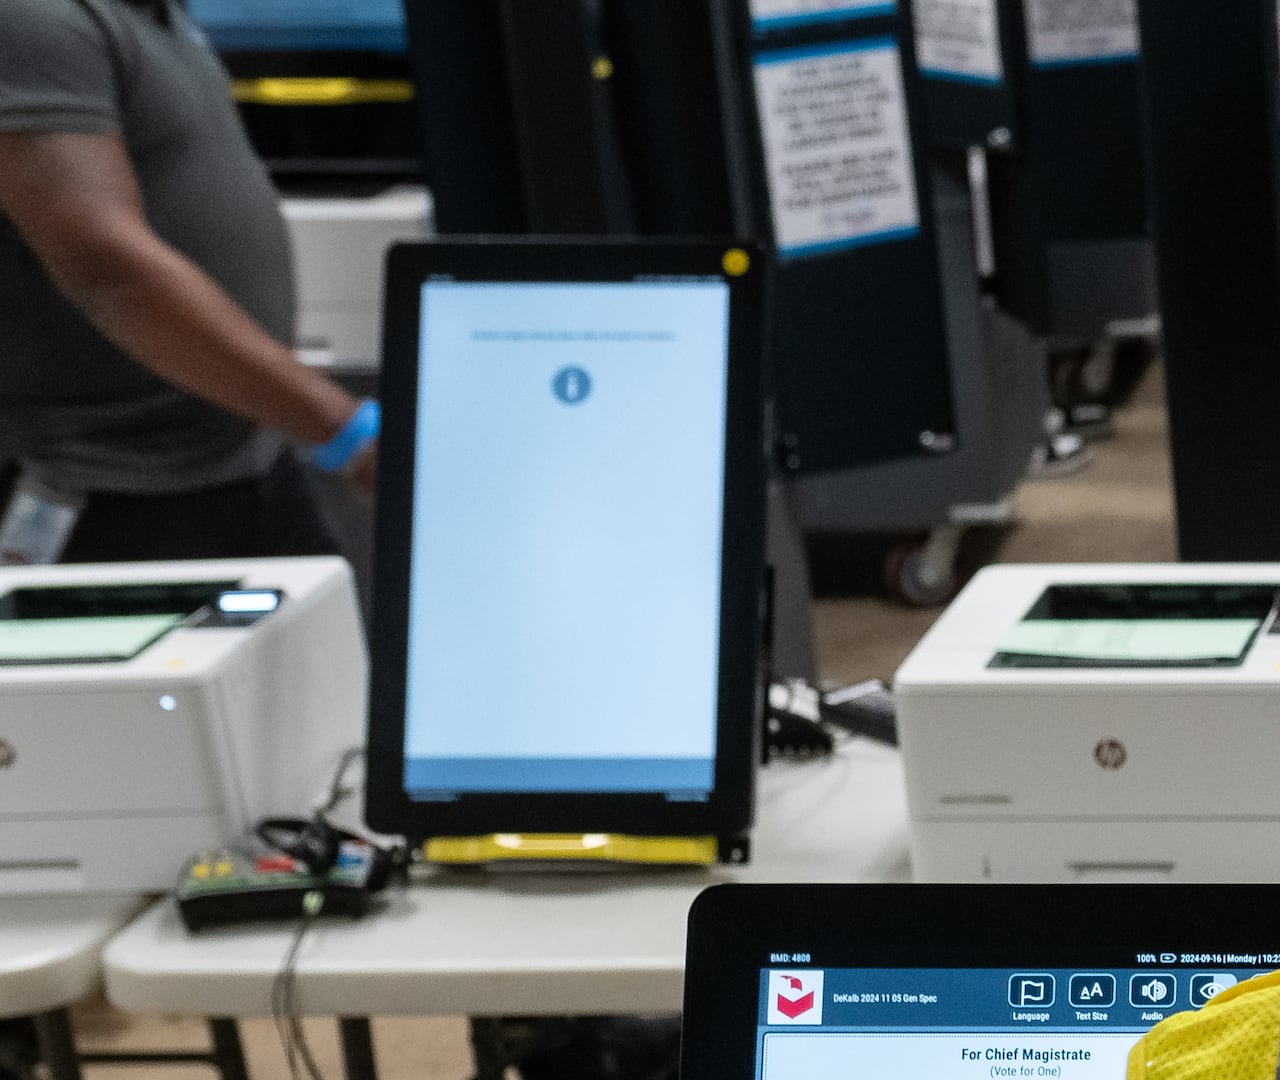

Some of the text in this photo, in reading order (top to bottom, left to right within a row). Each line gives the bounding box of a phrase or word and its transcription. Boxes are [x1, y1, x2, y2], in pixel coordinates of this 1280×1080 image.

[770, 953, 791, 963] BMD:
[1136, 954, 1156, 963] 100%
[1180, 954, 1222, 964] 2024-09-16
[1227, 954, 1256, 965] Monday
[833, 994, 938, 1005] DeKalb 2024 11 05 Gen Spec
[1012, 1012, 1050, 1023] Language
[1075, 1012, 1108, 1021] Text Size
[1141, 1012, 1163, 1021] Audio
[961, 1048, 1091, 1063] For Chief Magistrate
[990, 1066, 1061, 1078] (Vote for One)
